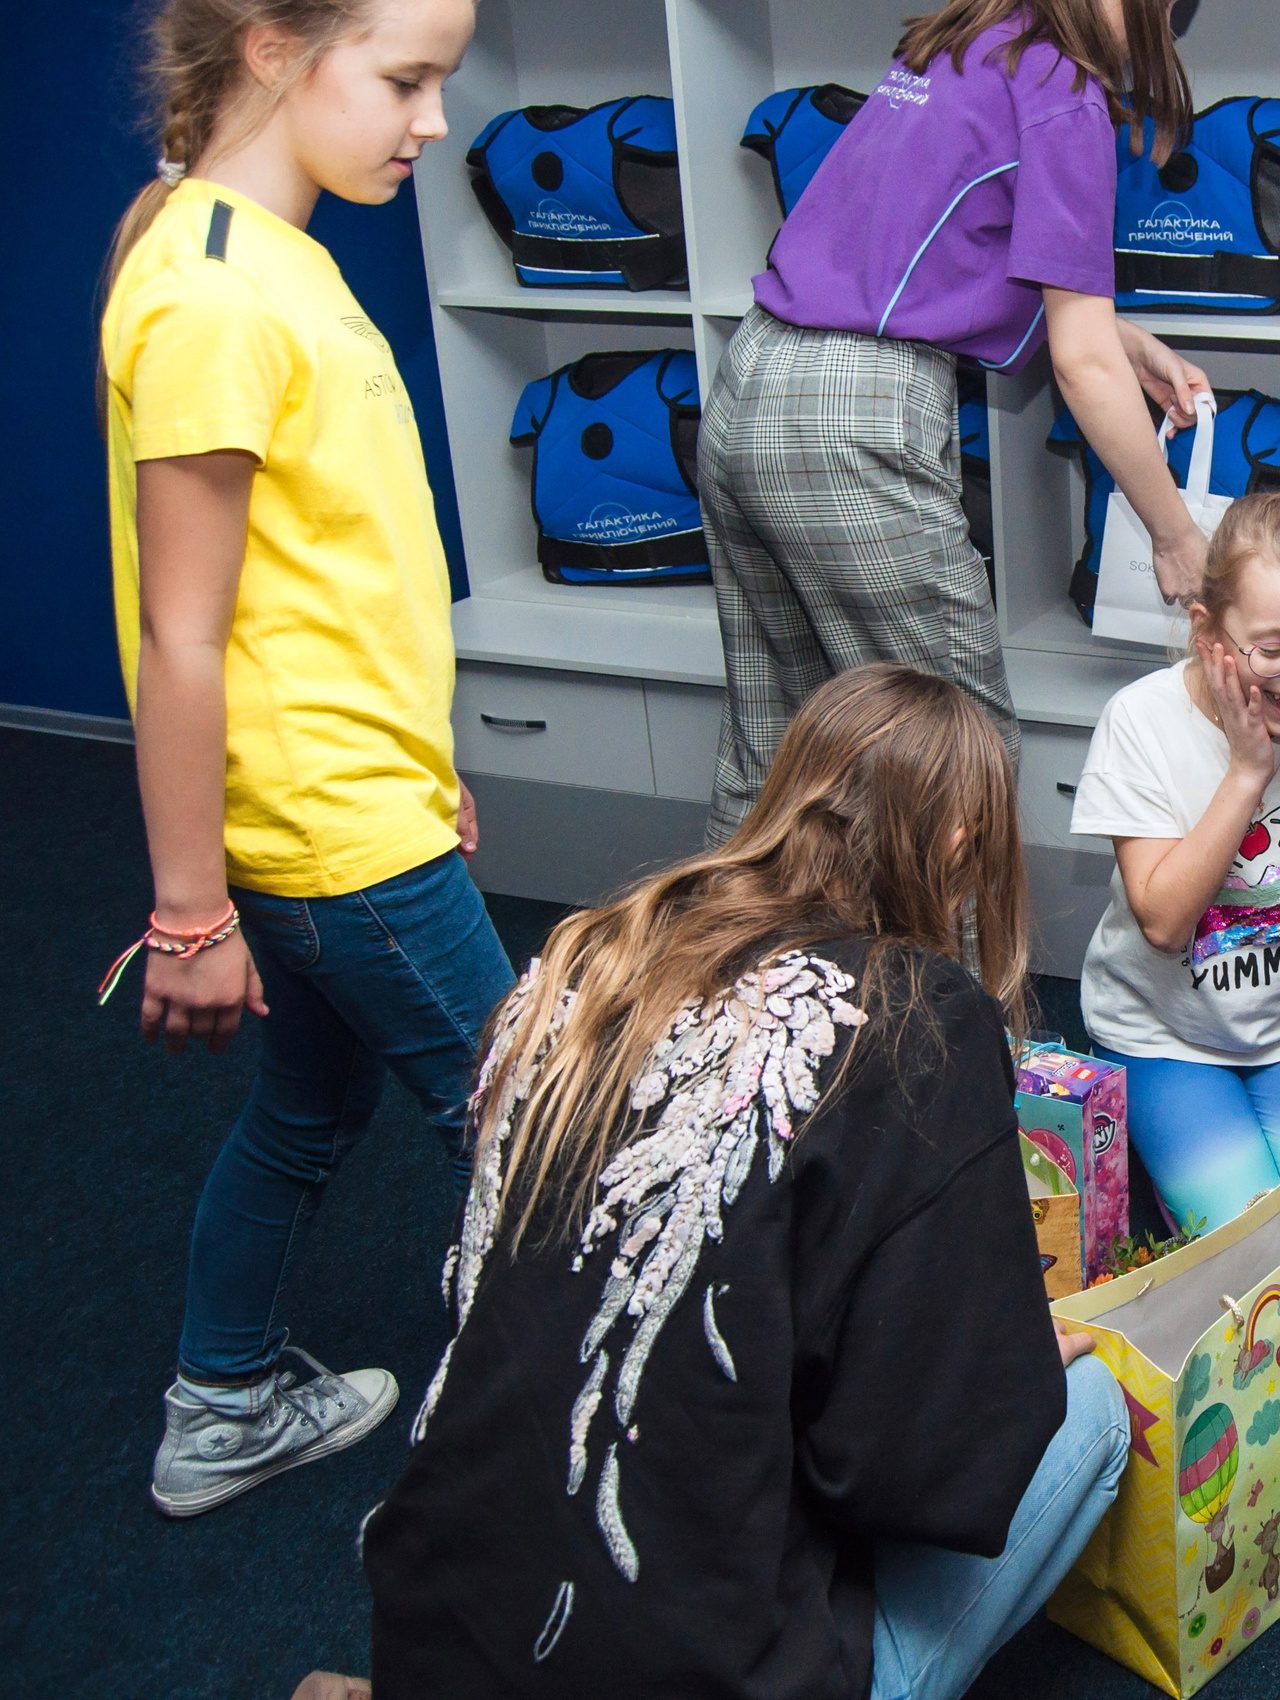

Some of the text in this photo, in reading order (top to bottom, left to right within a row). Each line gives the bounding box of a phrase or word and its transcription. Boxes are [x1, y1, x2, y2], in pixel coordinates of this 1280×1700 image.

[529, 211, 598, 222] ГАЛАКТИКА
[528, 220, 612, 231] ПРИКЛЮЧЕНИЙ
[1137, 218, 1221, 229] ГАЛАКТИКА
[1128, 231, 1234, 242] ПРИКЛЮЧЕНИЙ
[576, 511, 662, 531] ГАЛАКТИКА
[572, 517, 678, 540] ПРИКЛЮЧЕНИЙ
[1129, 560, 1155, 573] SOK
